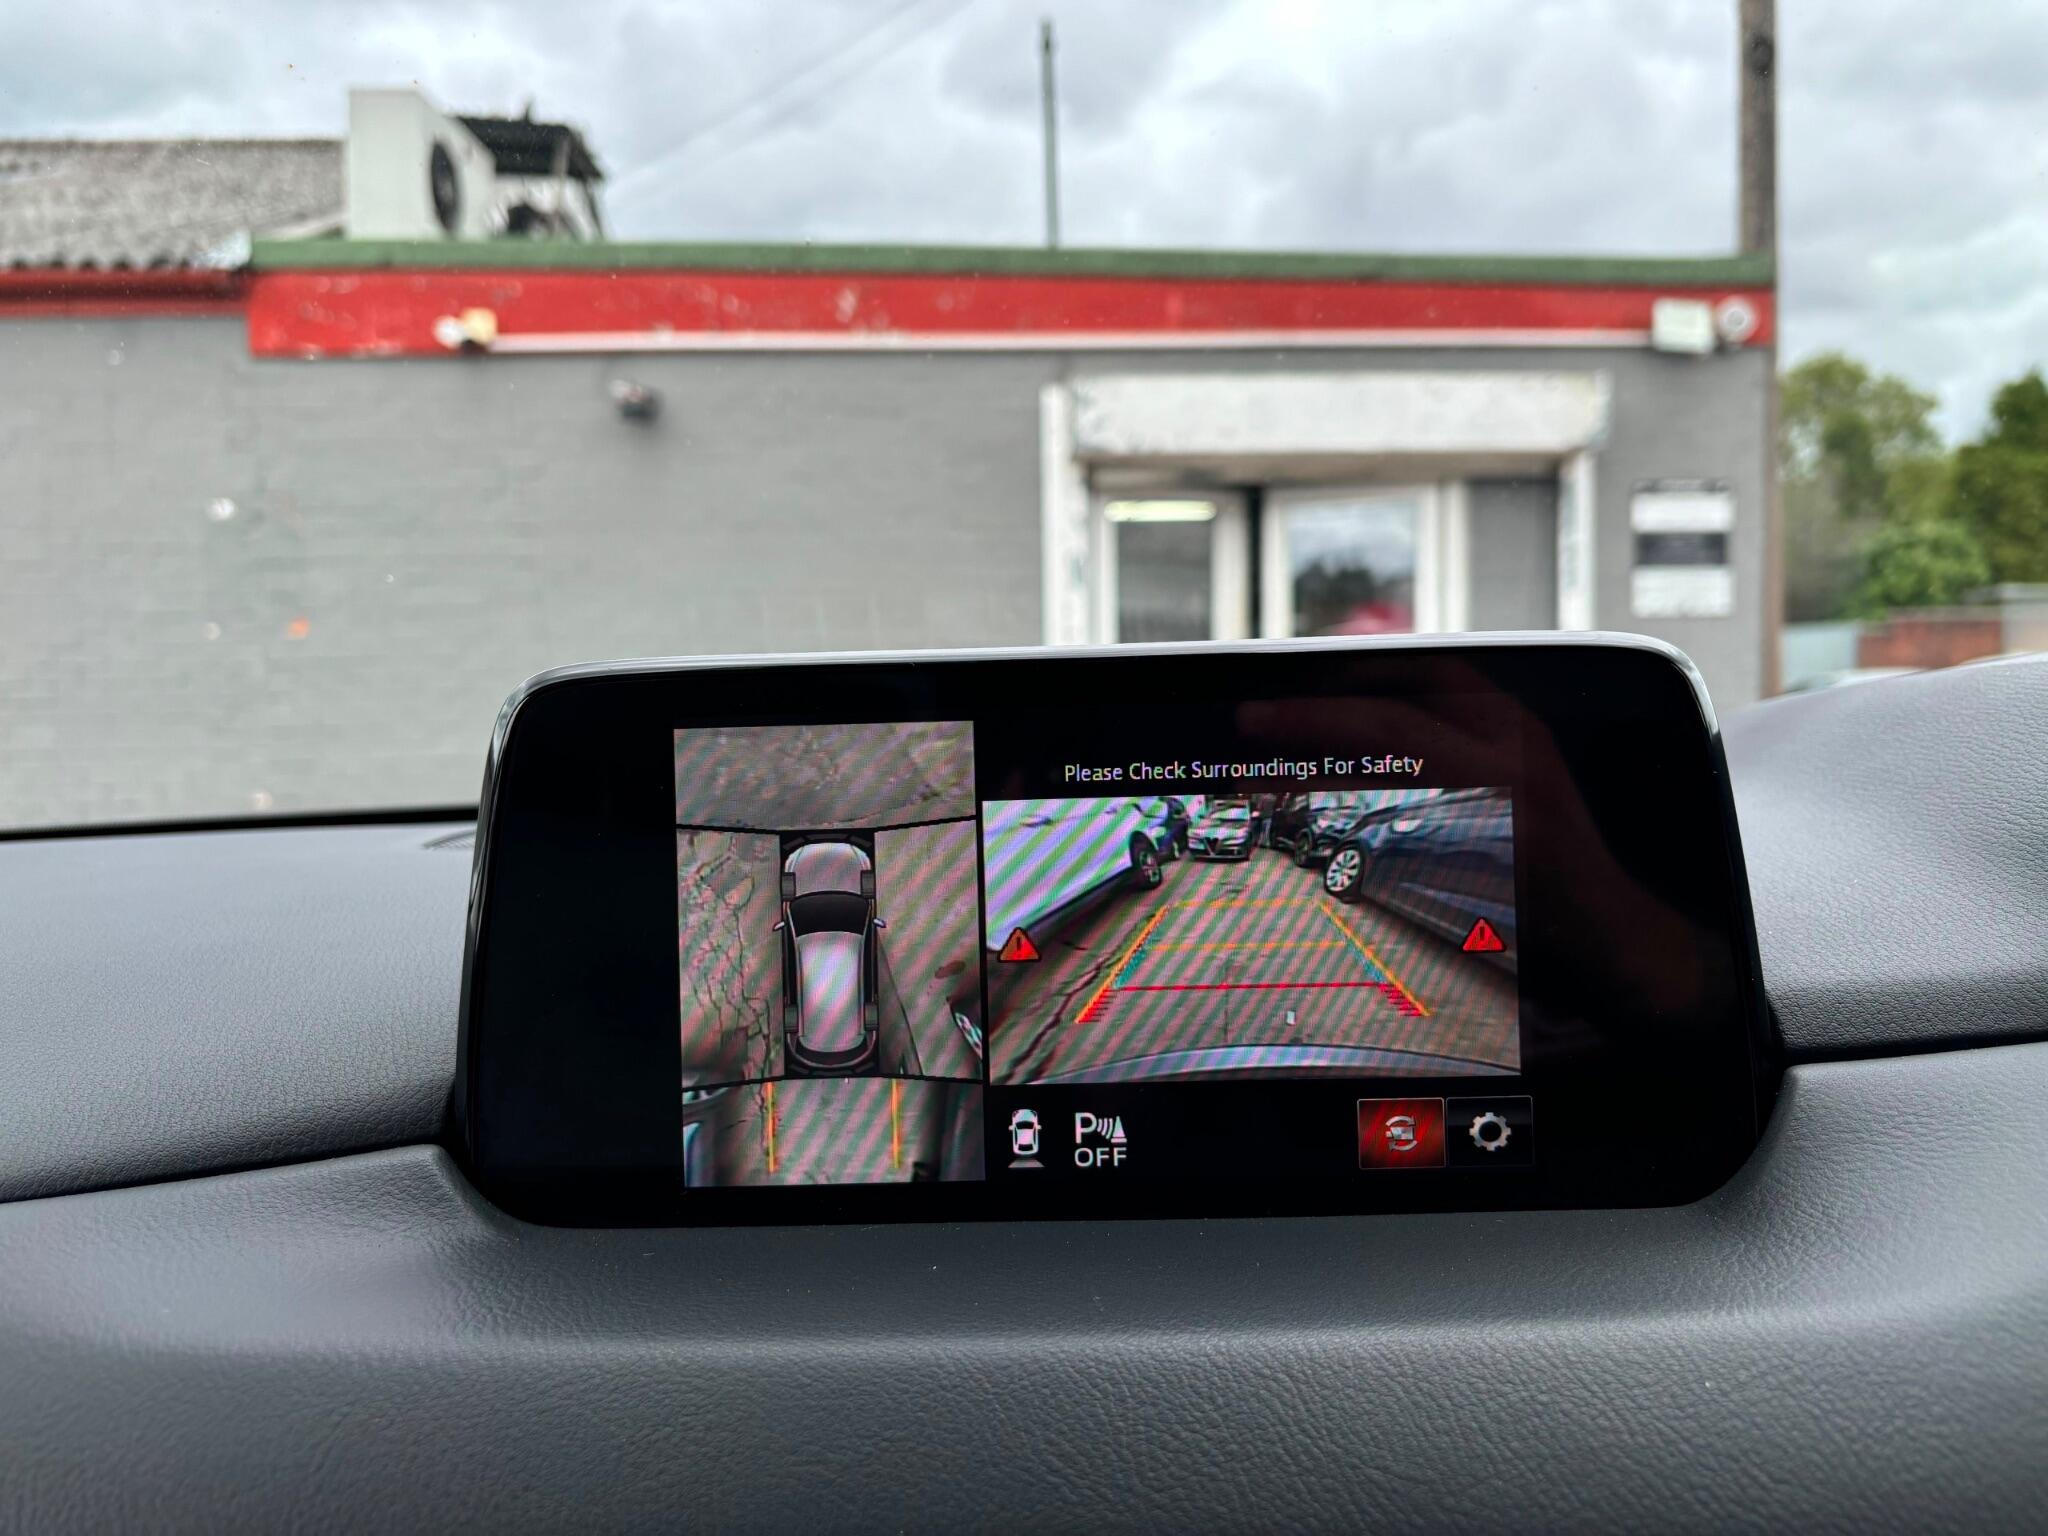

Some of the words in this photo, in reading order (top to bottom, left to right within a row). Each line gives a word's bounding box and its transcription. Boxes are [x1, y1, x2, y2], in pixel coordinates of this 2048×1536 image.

[1064, 764, 1123, 782] Please
[1129, 761, 1187, 780] Check
[1191, 758, 1317, 780] Surroundings
[1324, 757, 1354, 775] For
[1361, 755, 1424, 776] Safety
[1074, 1147, 1127, 1167] OFF
